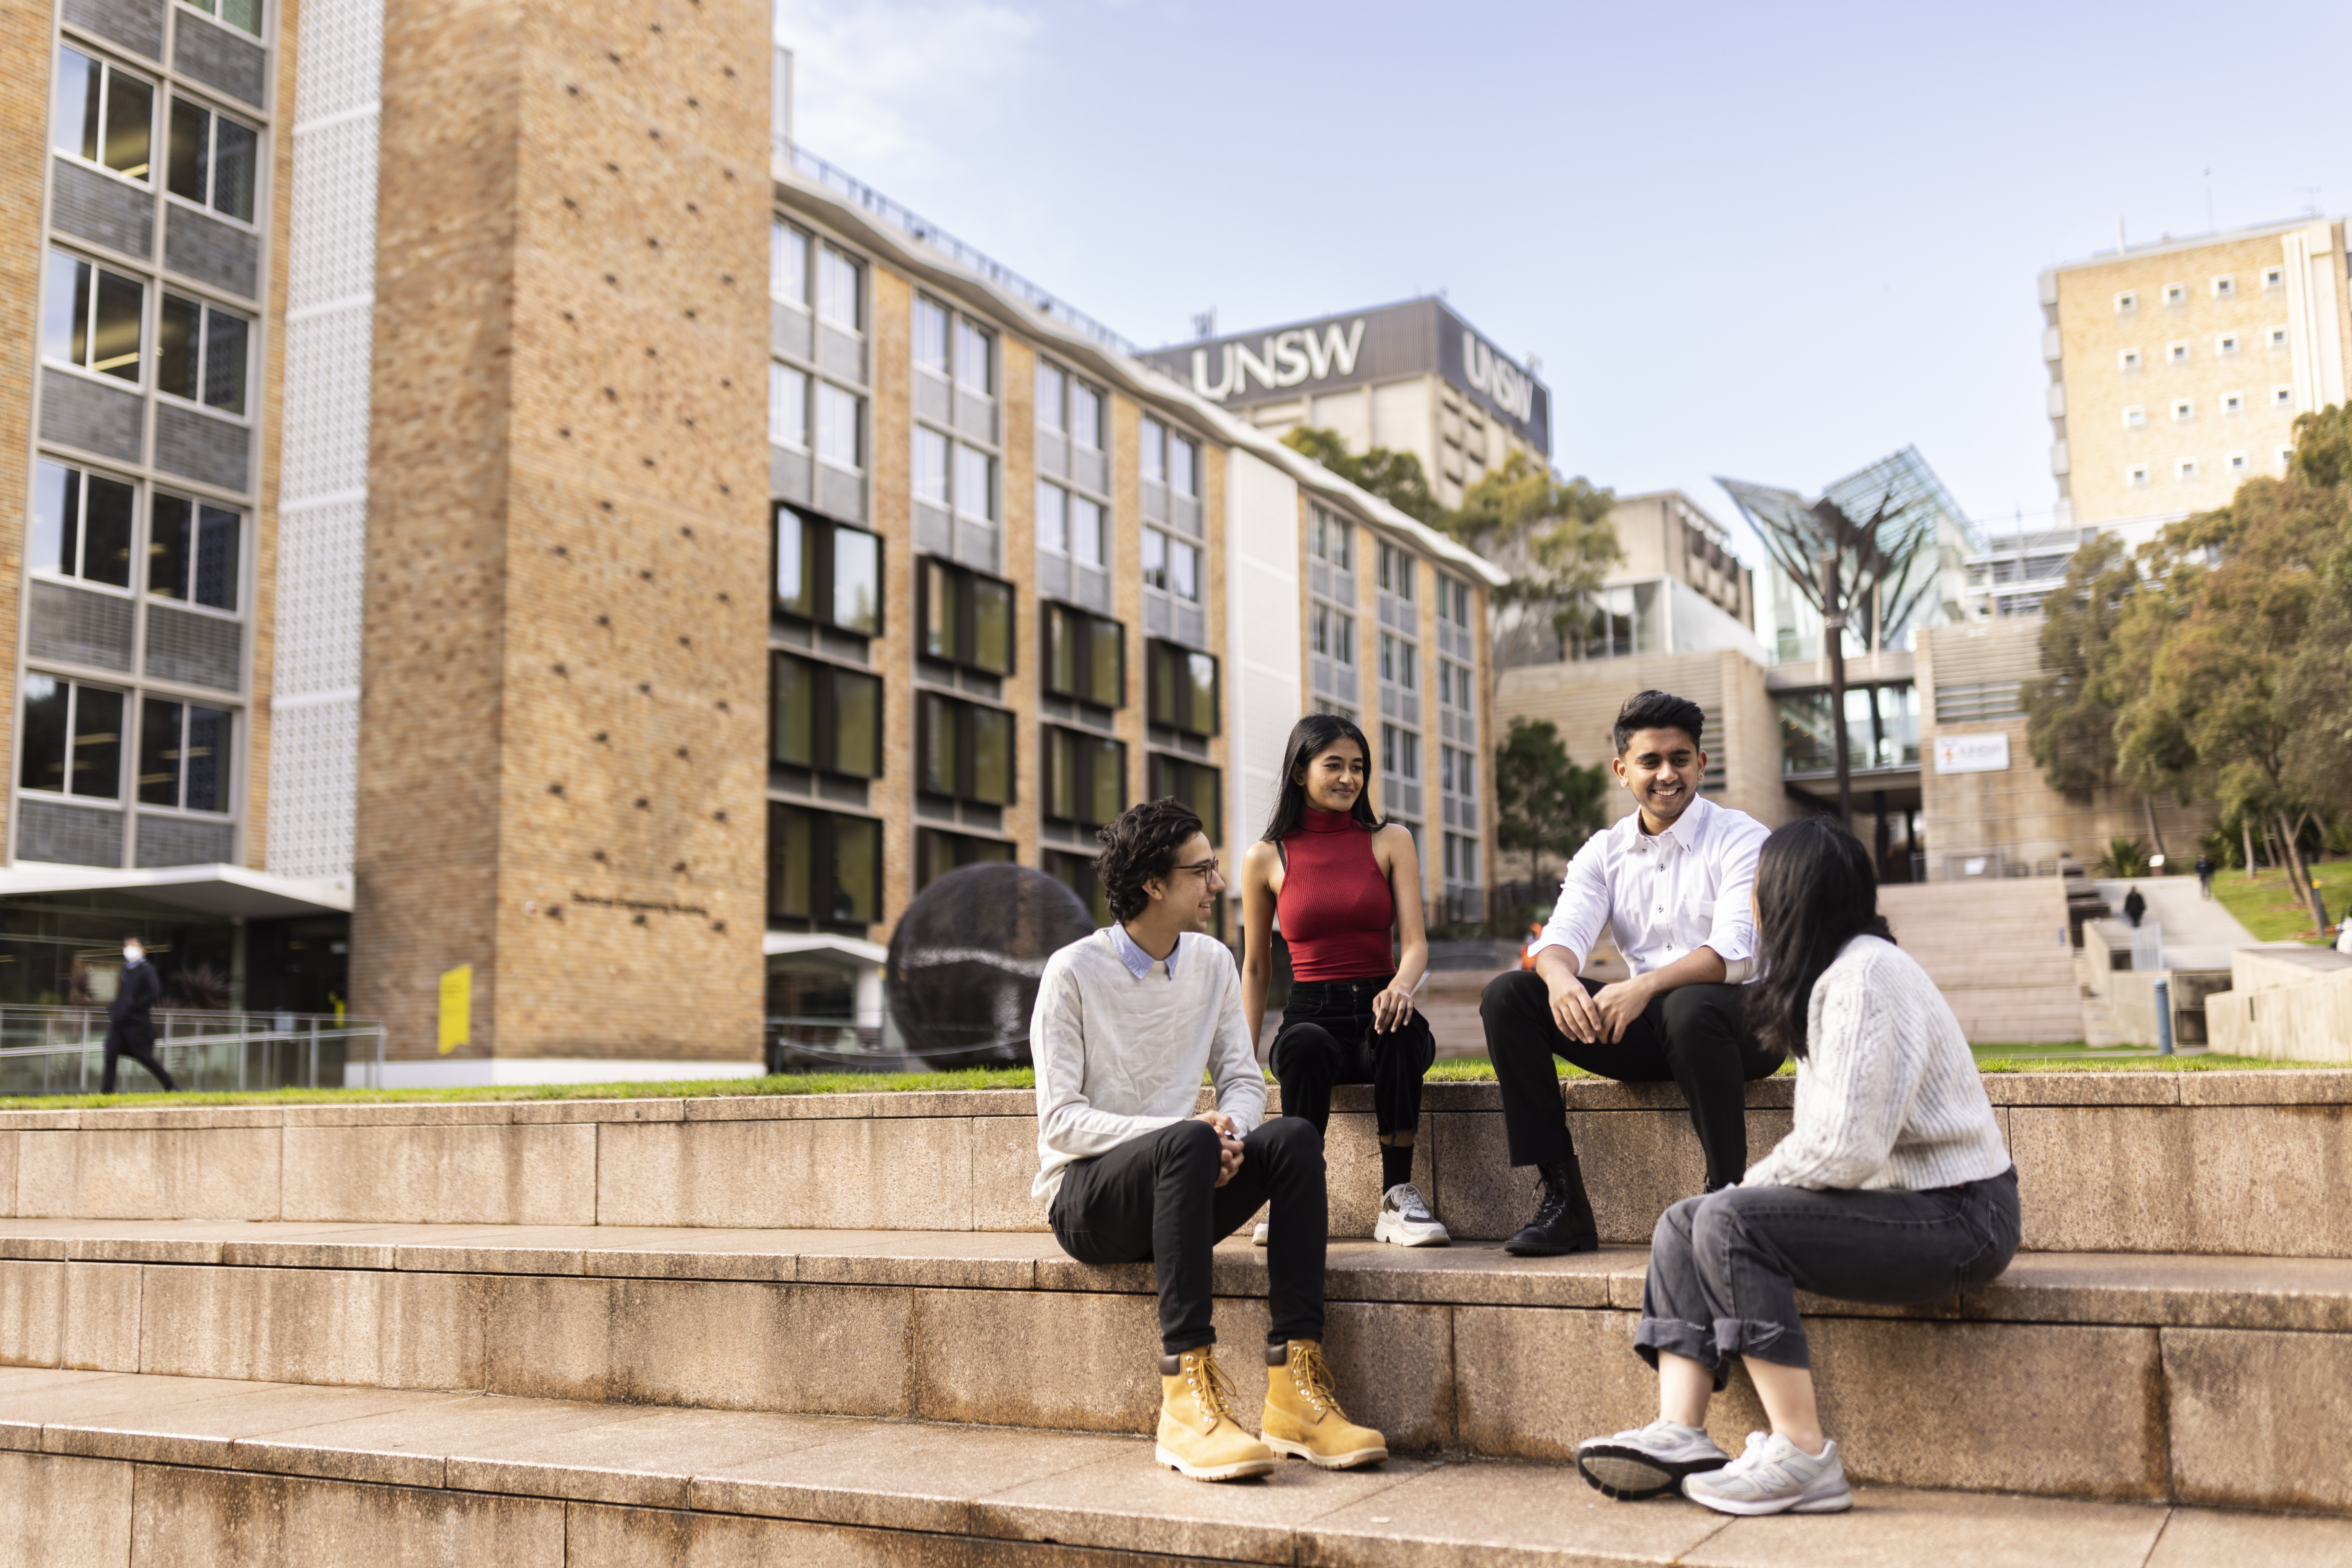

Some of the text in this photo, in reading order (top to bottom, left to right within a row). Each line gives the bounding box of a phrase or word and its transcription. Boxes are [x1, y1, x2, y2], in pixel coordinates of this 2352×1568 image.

[1192, 318, 1366, 401] UNSW
[1463, 330, 1533, 424] UNSW
[1960, 744, 2002, 759] US
[1748, 1467, 1789, 1494] N
